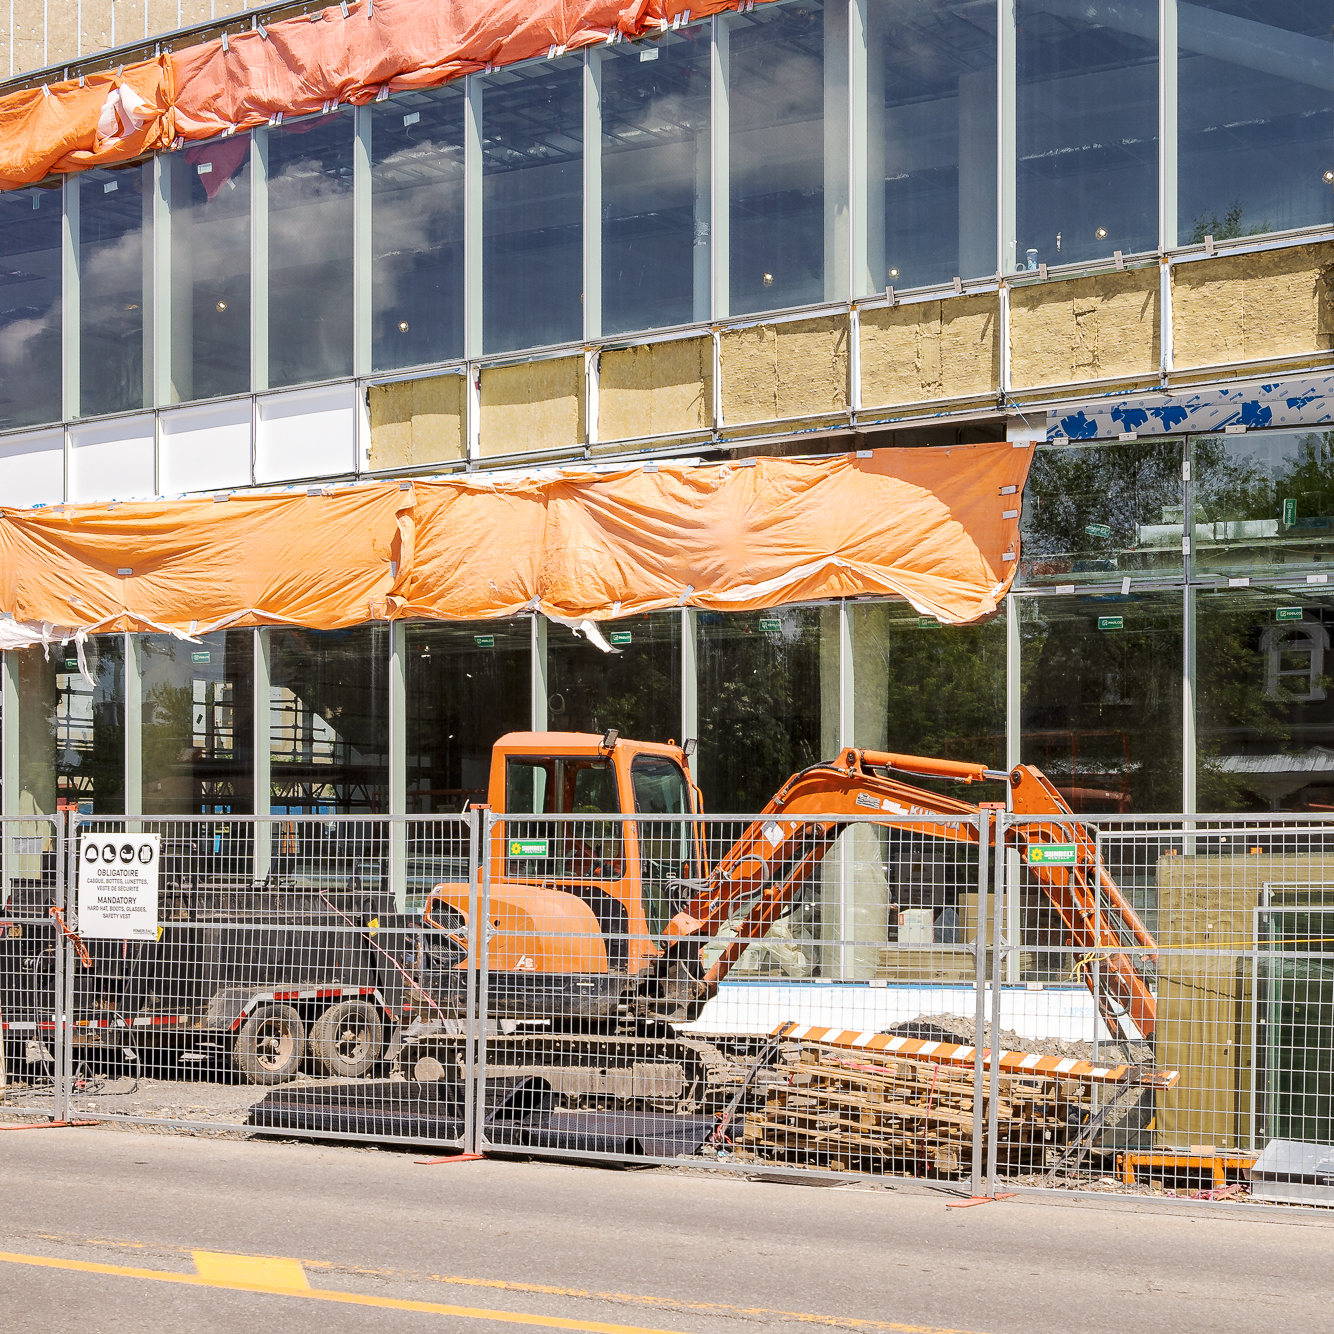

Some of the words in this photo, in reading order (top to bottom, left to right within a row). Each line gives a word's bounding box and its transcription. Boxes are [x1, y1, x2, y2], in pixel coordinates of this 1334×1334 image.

[909, 805, 960, 831] KUTA
[97, 869, 139, 877] OBLIGATOIRE
[97, 896, 137, 904] MANDATORY
